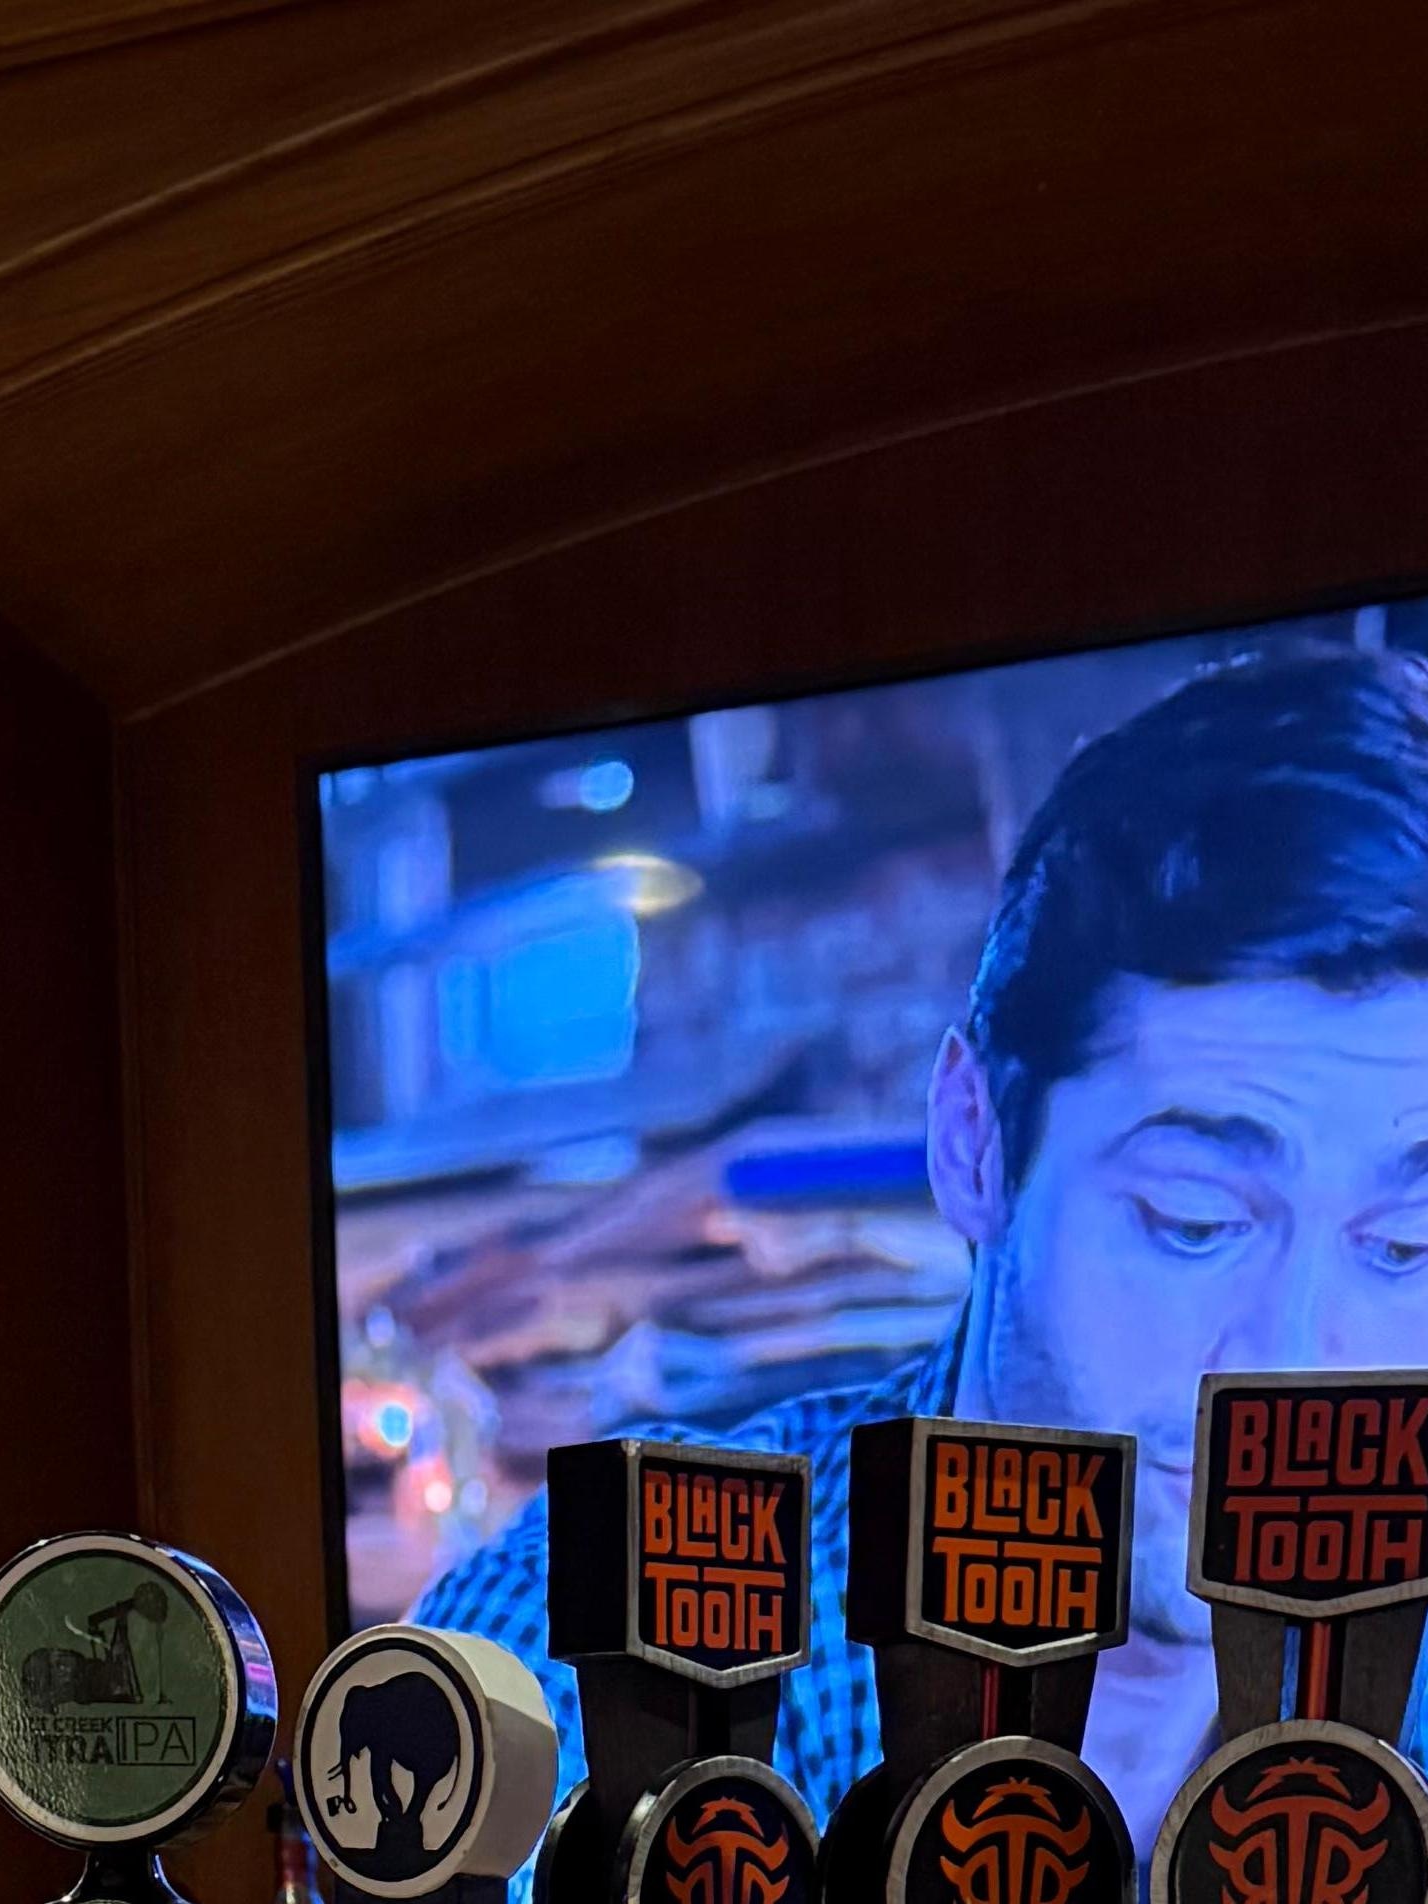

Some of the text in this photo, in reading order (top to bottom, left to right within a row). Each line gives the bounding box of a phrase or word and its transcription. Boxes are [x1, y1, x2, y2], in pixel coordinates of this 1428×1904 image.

[644, 1468, 786, 1564] BLACK
[934, 1441, 1105, 1539] BLACK
[933, 1536, 1102, 1630] TOOTH
[1223, 1494, 1428, 1583] TOOTH
[644, 1561, 786, 1653] TOOTH
[119, 1719, 192, 1761] IPA
